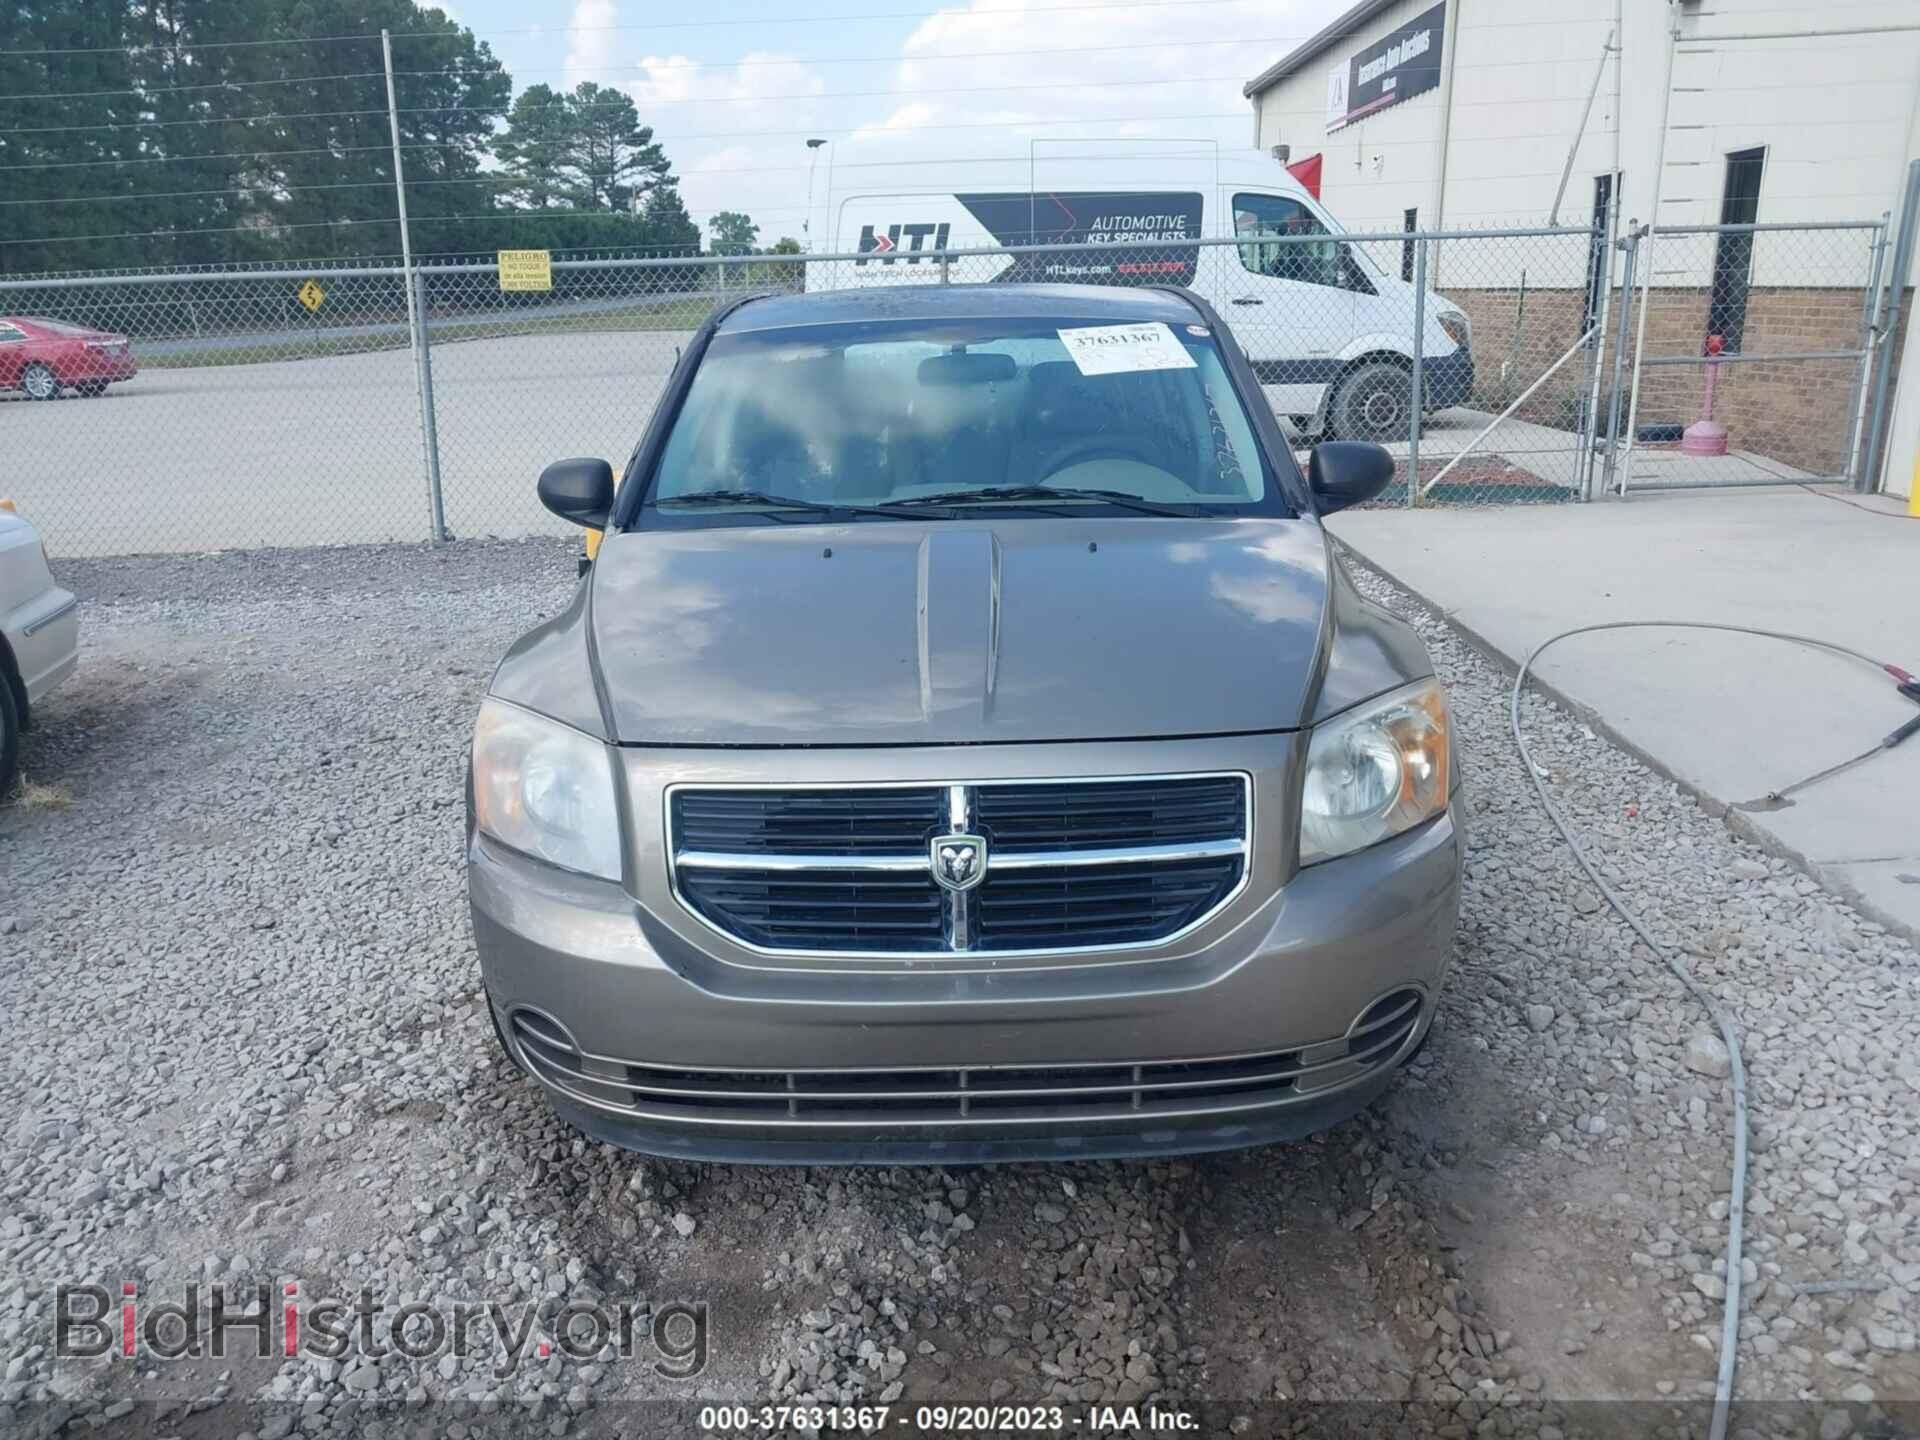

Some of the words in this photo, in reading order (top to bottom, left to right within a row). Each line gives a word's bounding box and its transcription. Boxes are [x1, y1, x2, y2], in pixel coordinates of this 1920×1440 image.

[1091, 215, 1187, 231] AUTOMOTIVE
[856, 223, 960, 266] HTL
[1087, 232, 1112, 244] KEY
[1113, 230, 1187, 244] SPECIALISTS
[501, 252, 548, 262] PELIGRO
[1073, 332, 1161, 347] 37631367
